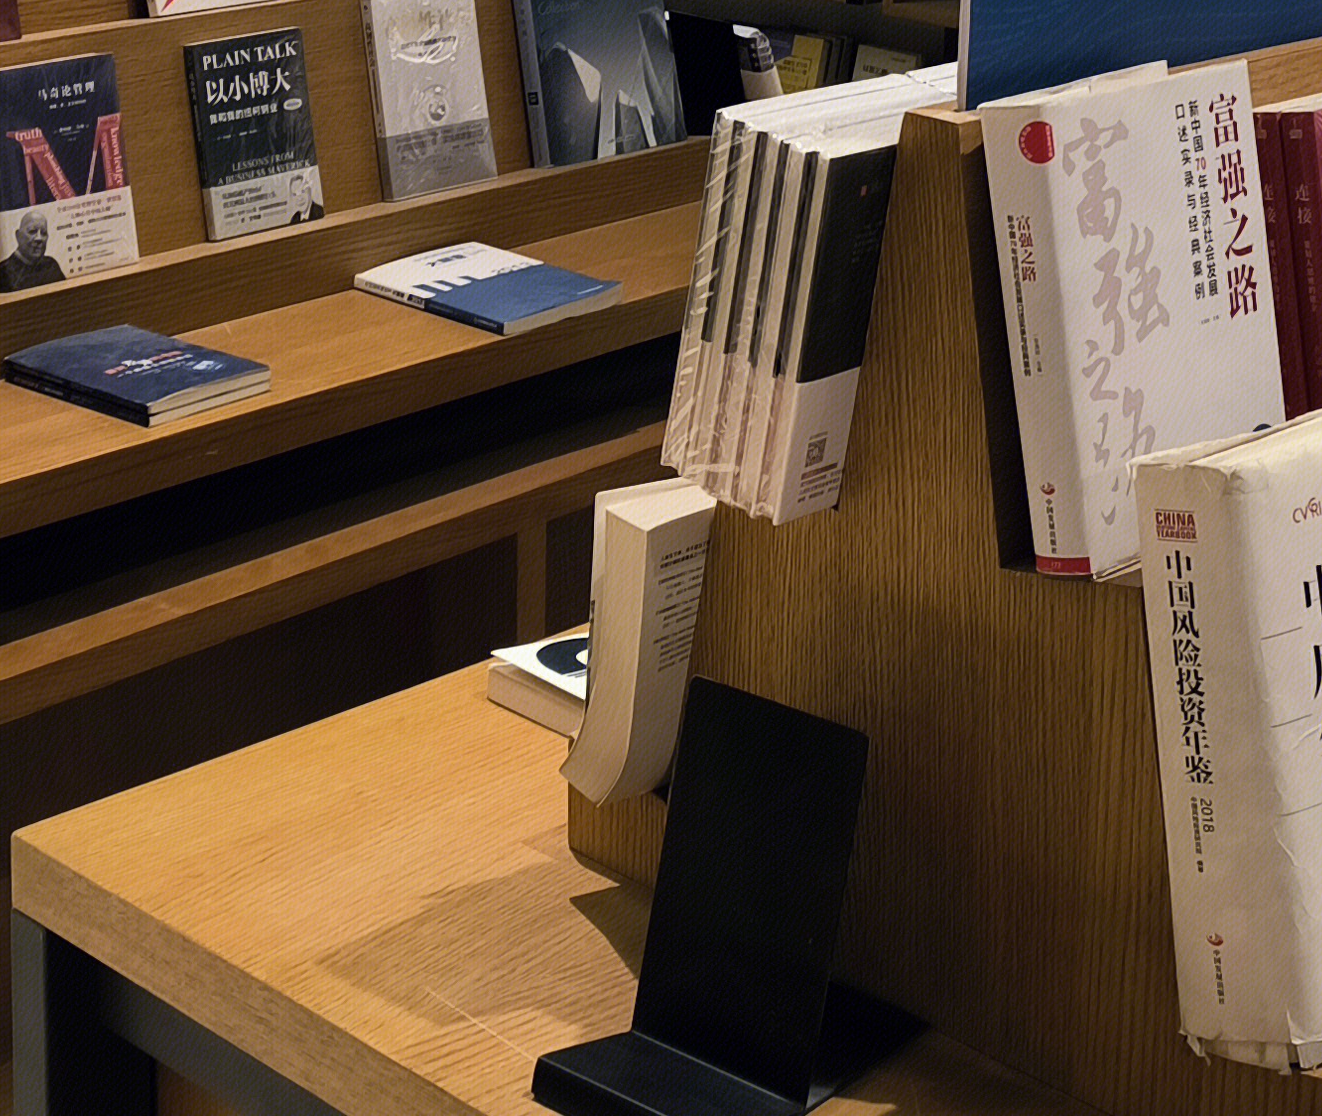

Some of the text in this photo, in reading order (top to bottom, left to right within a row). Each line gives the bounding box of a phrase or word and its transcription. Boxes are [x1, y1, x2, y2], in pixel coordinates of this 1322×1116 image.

[202, 41, 298, 71] PLAIN TALK
[205, 67, 292, 107] 以小博大
[1208, 93, 1259, 320] 富强之路
[1155, 511, 1195, 527] CHINA
[1163, 549, 1214, 785] 中国风险投资年鉴
[1198, 798, 1215, 833] 2018
